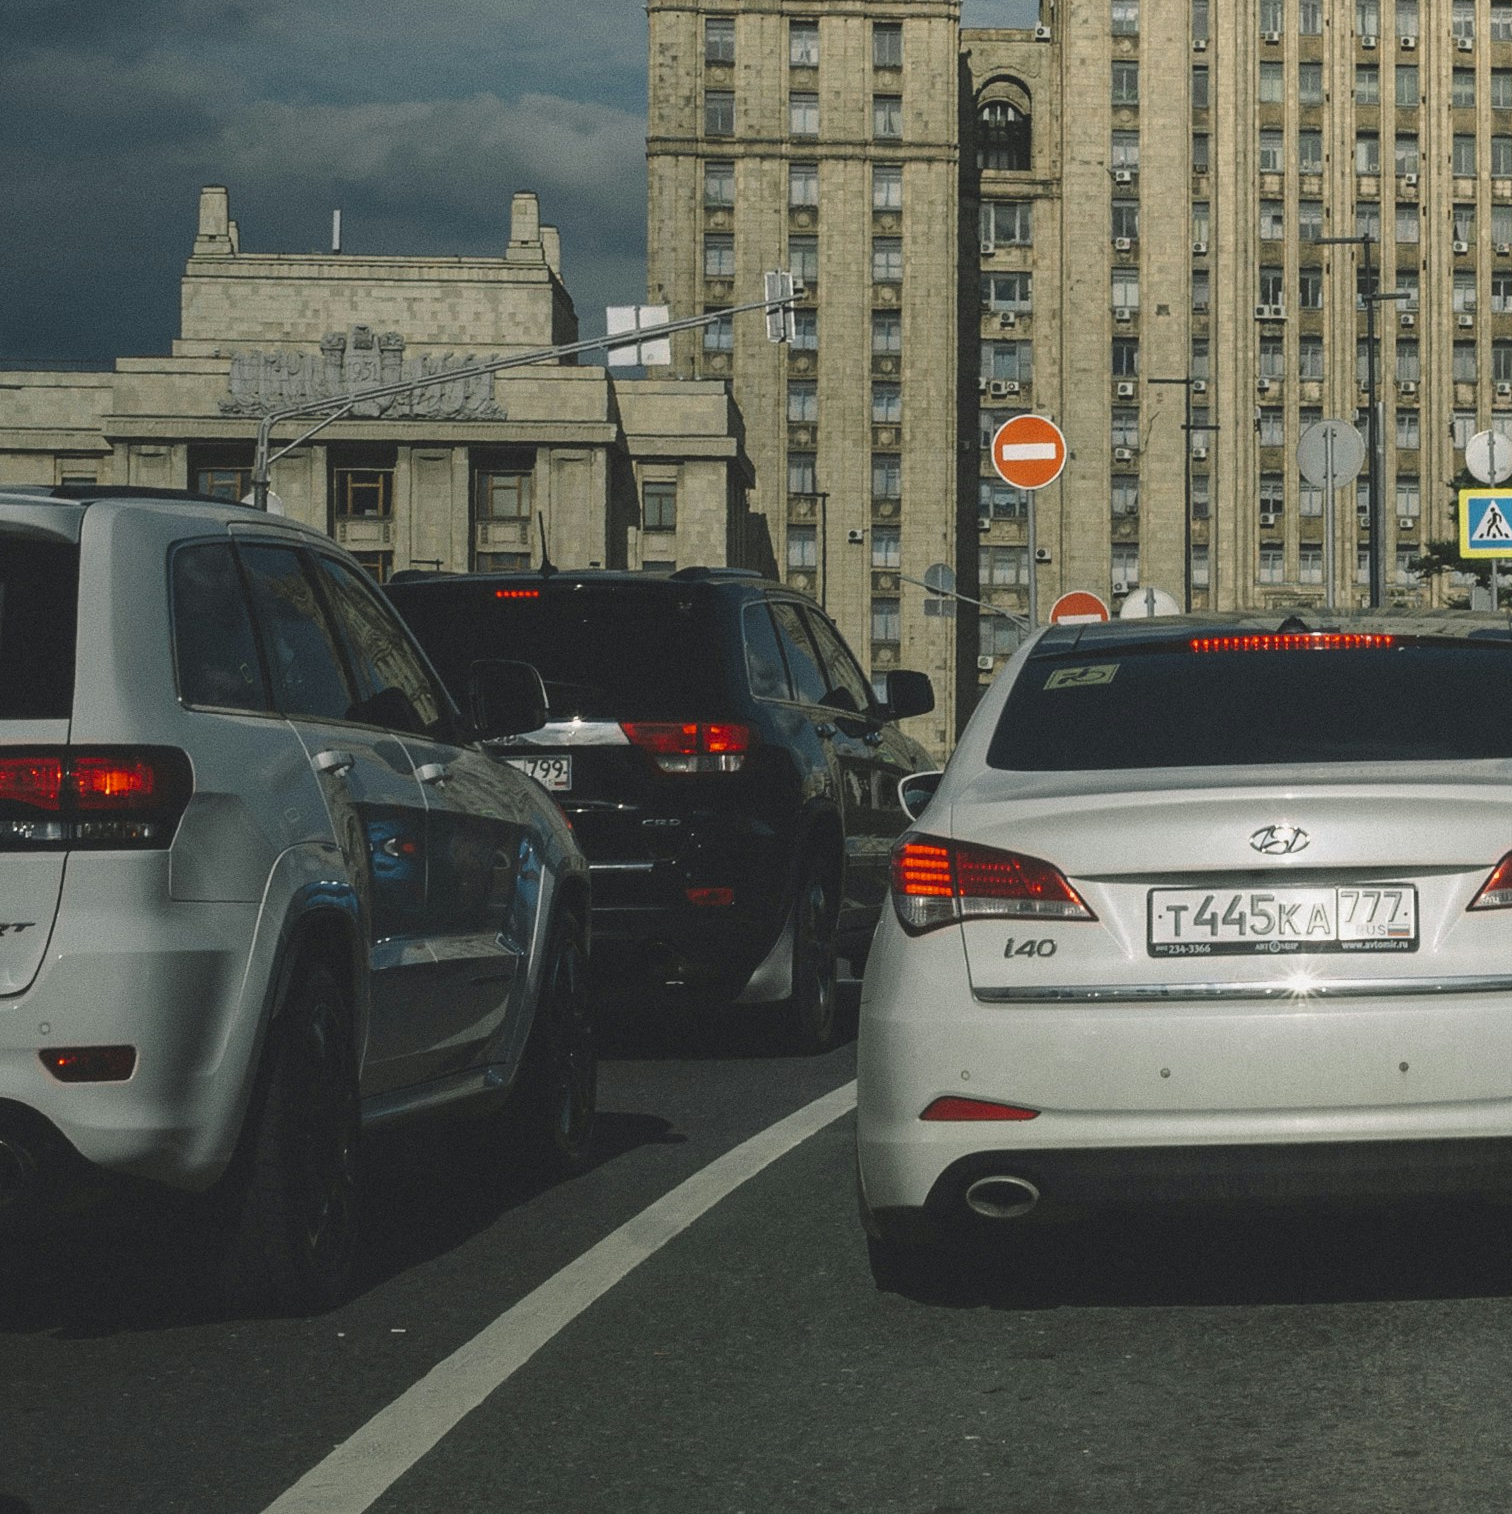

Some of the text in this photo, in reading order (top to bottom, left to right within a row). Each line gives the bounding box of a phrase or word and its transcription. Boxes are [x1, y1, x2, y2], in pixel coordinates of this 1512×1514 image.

[526, 760, 563, 779] 799
[1341, 890, 1403, 923] 777
[1356, 924, 1386, 936] RUS
[1004, 938, 1058, 959] i40
